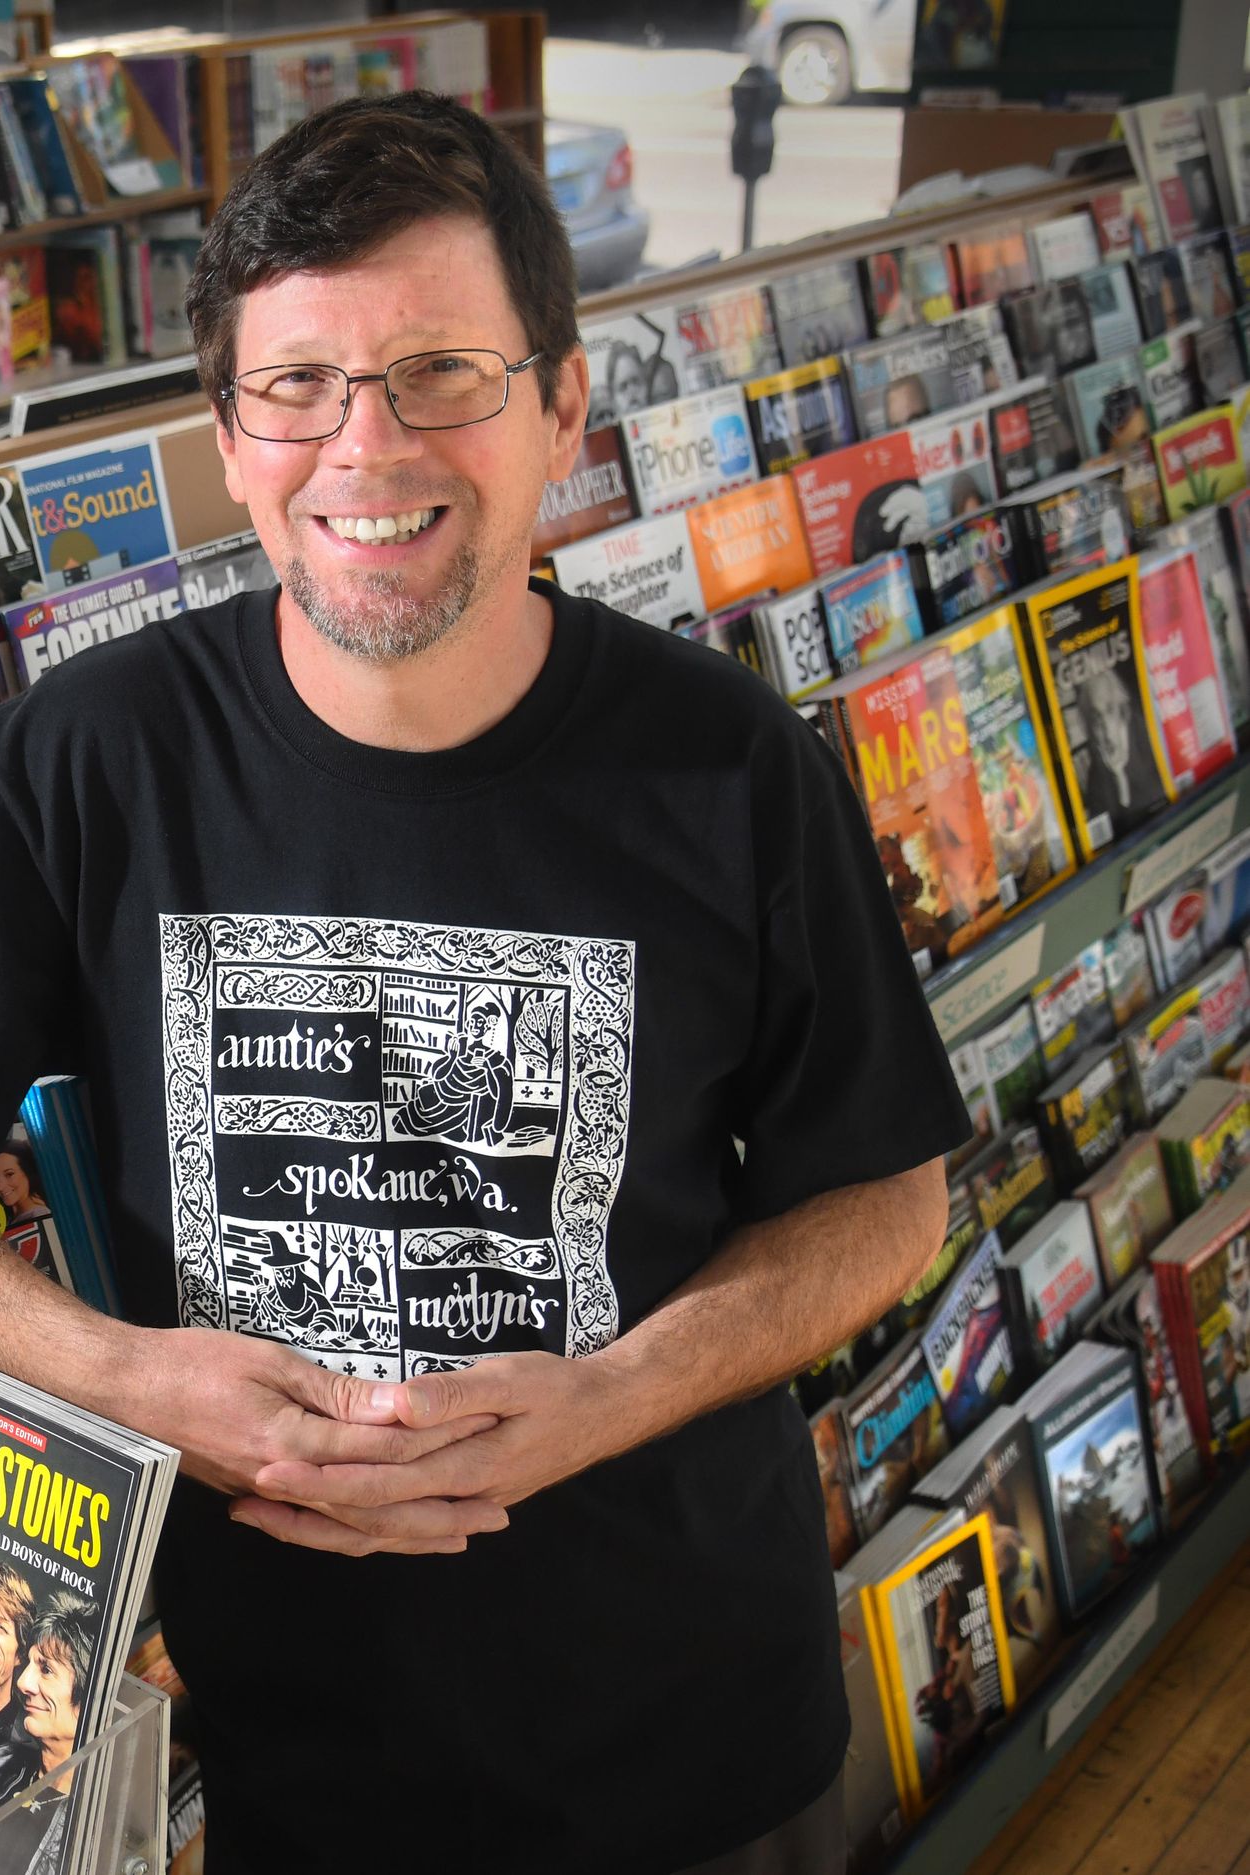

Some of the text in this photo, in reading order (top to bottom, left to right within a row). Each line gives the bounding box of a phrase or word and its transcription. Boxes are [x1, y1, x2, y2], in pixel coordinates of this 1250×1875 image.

[603, 534, 641, 565] TIME
[609, 561, 665, 596] Science
[666, 546, 685, 573] of
[51, 577, 147, 624] THE ULTIMATE GUIDE TO
[785, 608, 825, 651] POP
[798, 645, 828, 684] SCI
[1056, 630, 1131, 690] GENIUS
[866, 674, 921, 714] MISSION
[859, 697, 969, 802] MARS
[217, 1018, 371, 1074] auntie's
[405, 1271, 560, 1342] merlyn's
[15, 1426, 44, 1448] EDITION
[10, 1539, 43, 1570] BOYS
[42, 1555, 62, 1576] OF
[60, 1566, 96, 1599] ROCK
